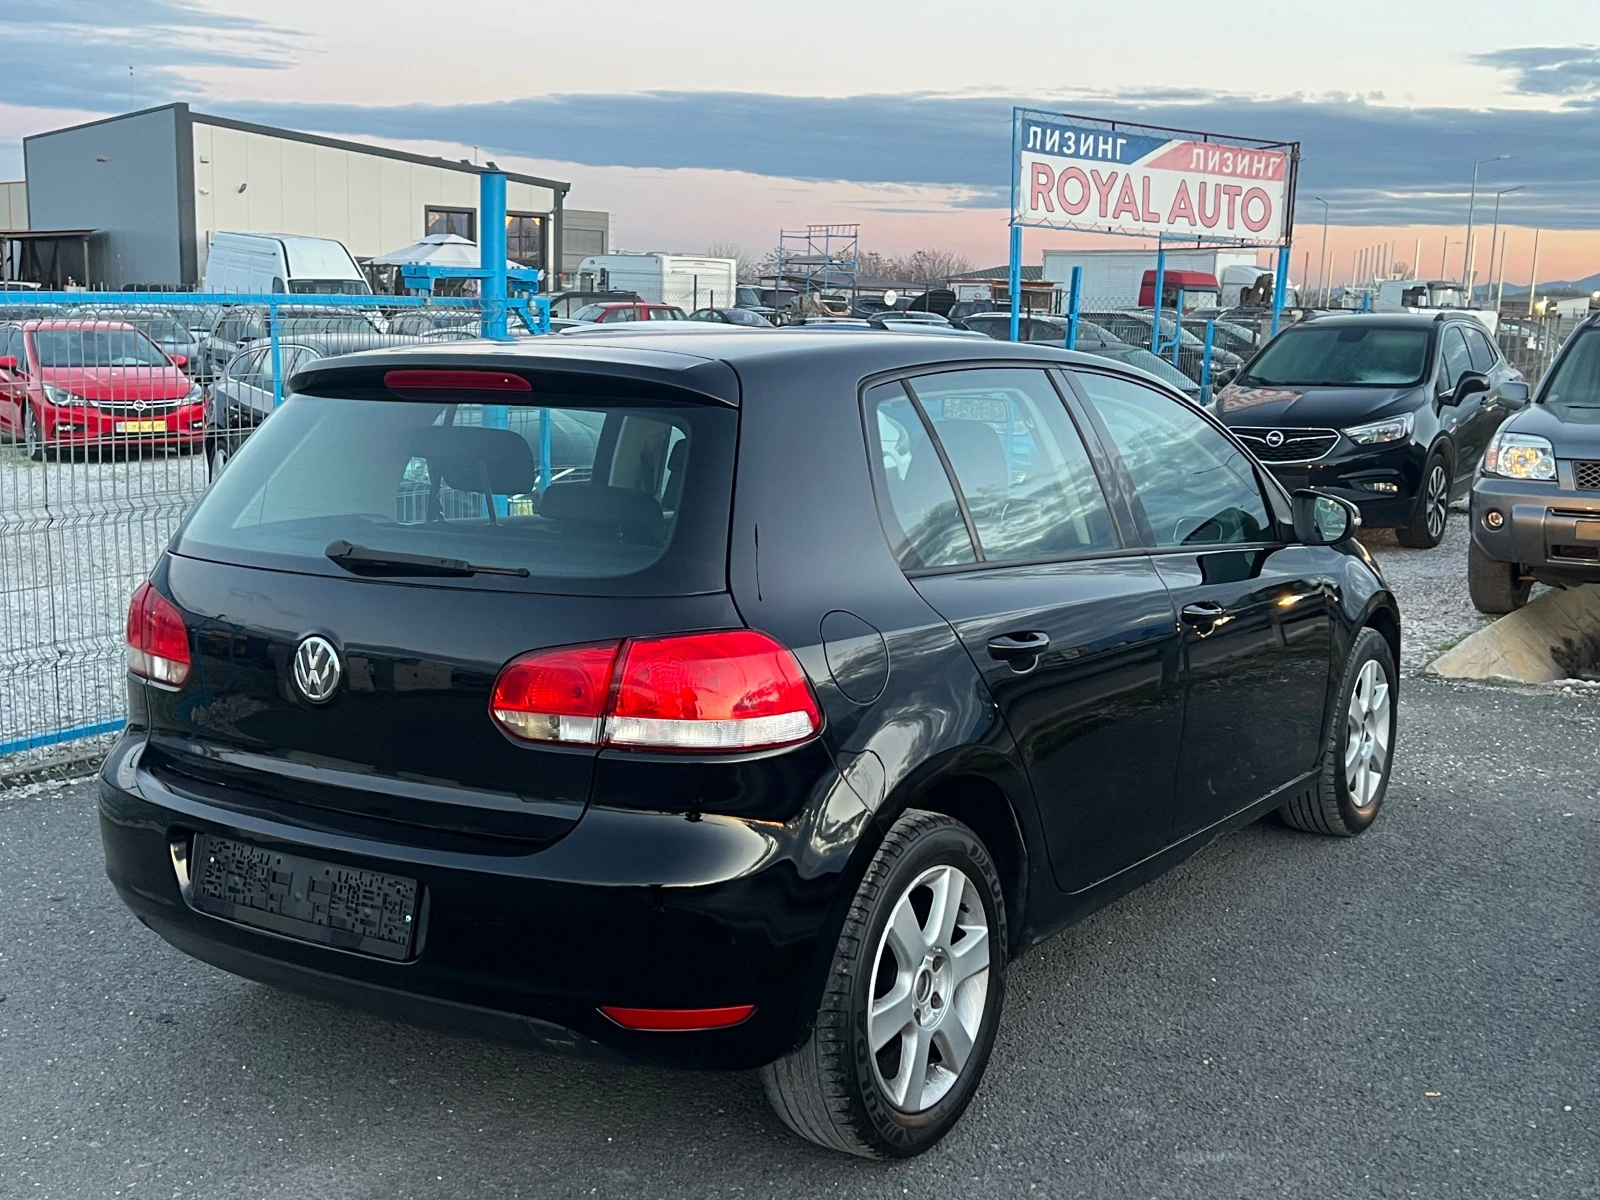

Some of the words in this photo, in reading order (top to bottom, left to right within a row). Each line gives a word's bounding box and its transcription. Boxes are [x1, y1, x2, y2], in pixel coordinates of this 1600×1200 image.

[1026, 125, 1127, 160] ЛИЗИНГ
[1189, 147, 1281, 178] ЛИЗИНГ
[1030, 161, 1161, 223] ROYAL
[1167, 179, 1272, 232] AUTO
